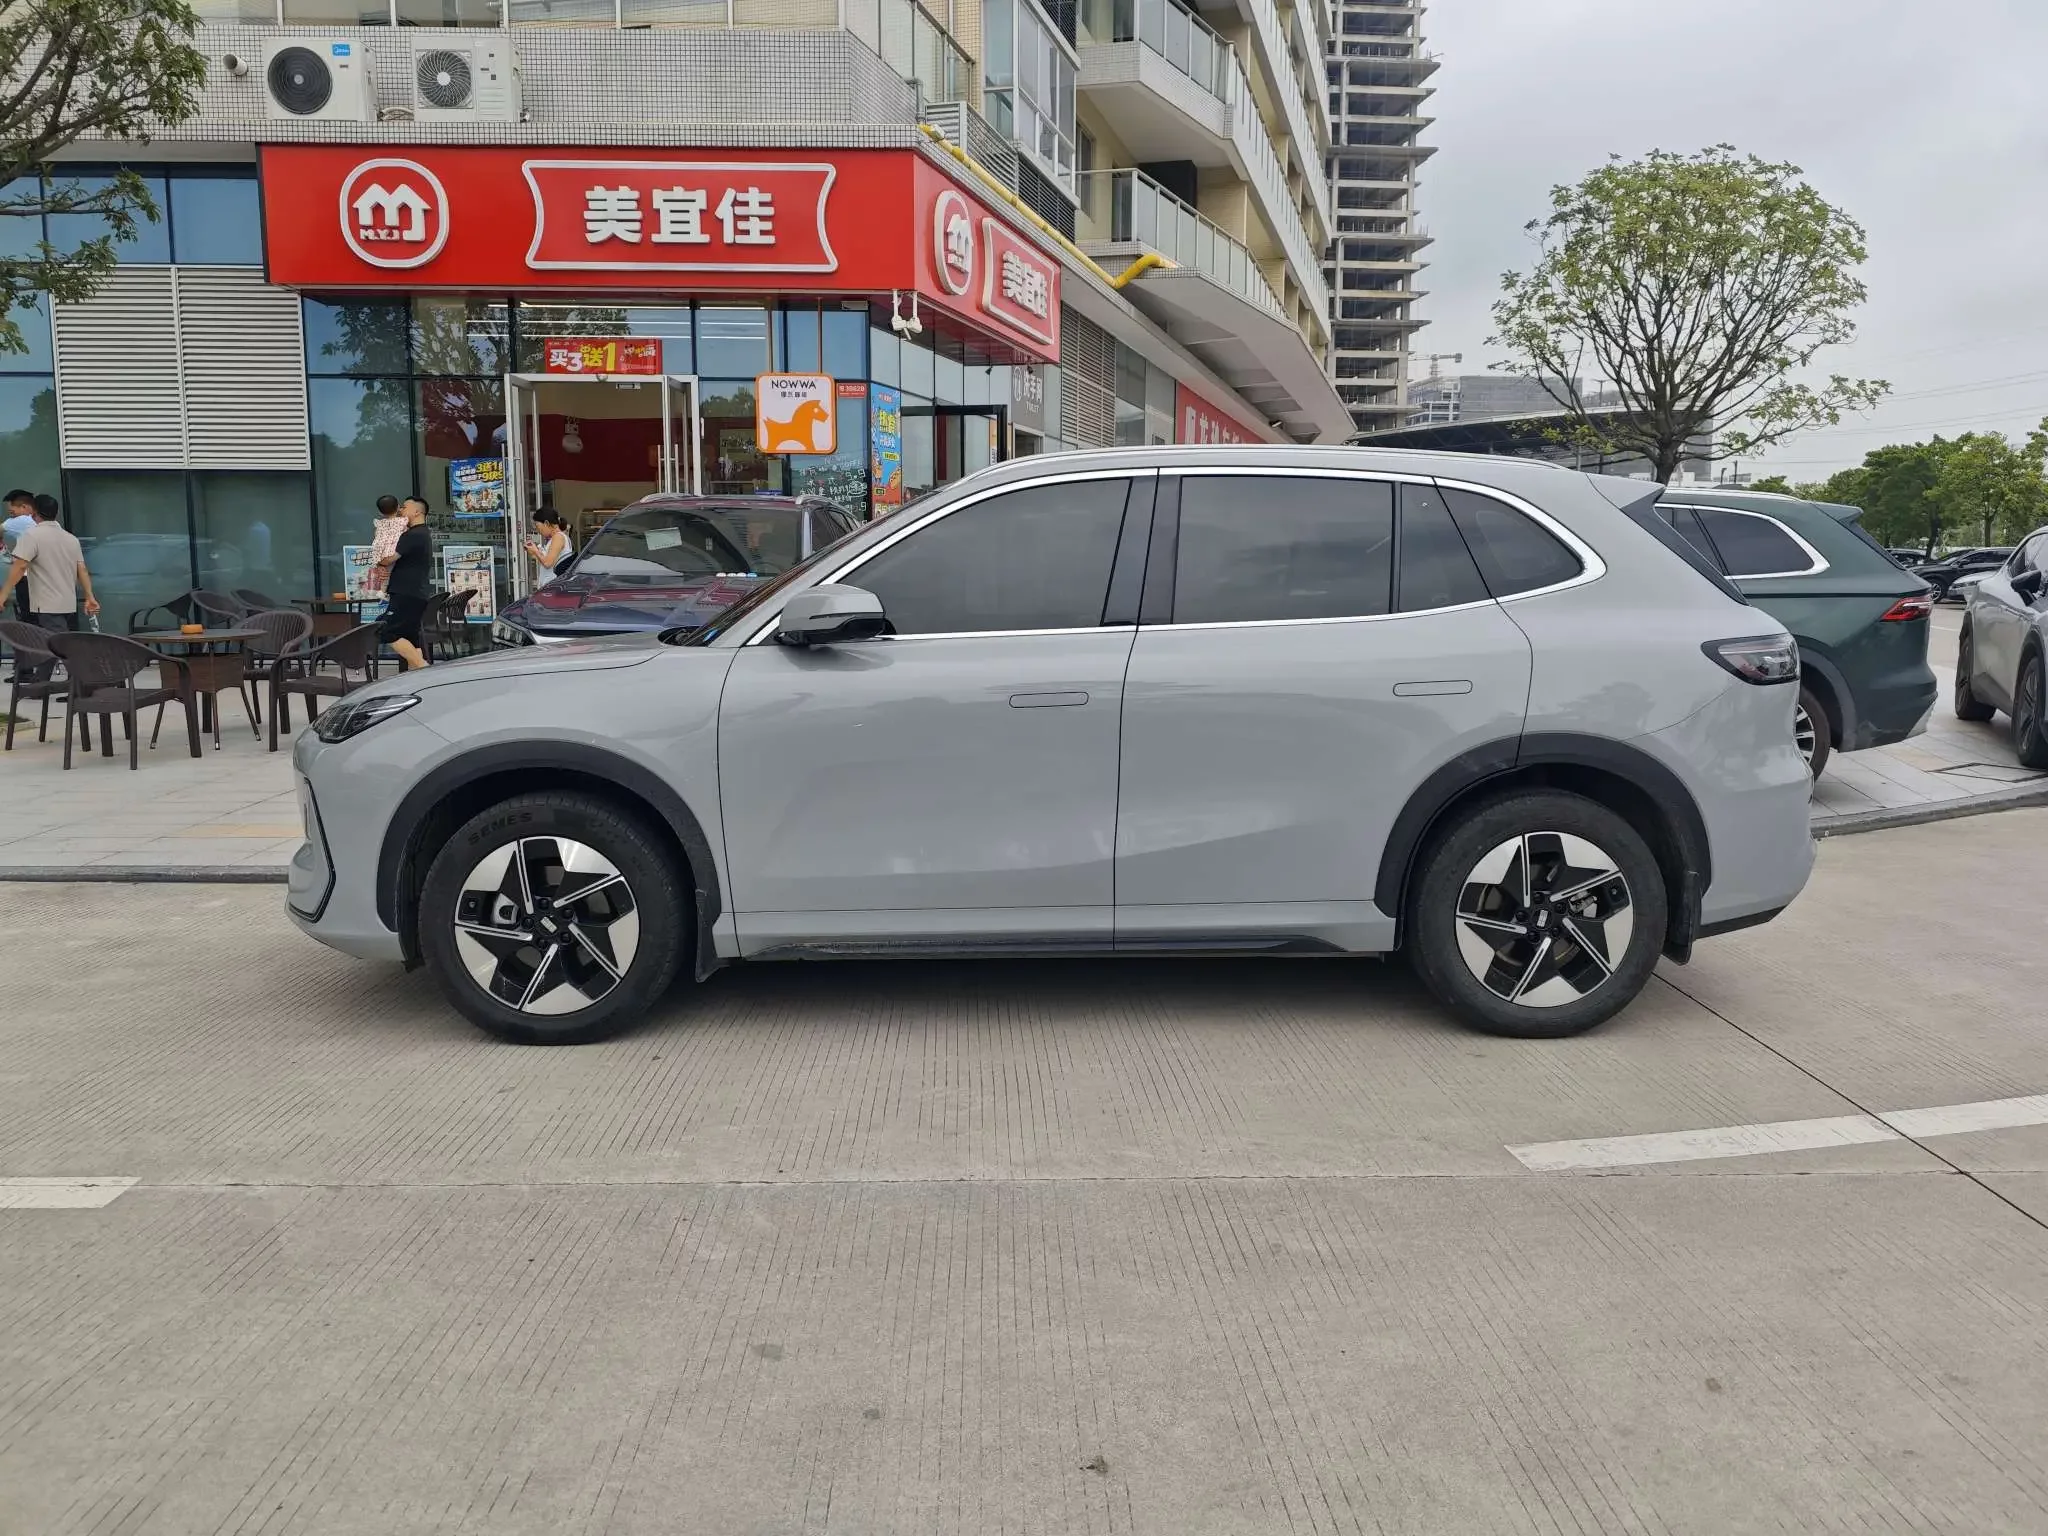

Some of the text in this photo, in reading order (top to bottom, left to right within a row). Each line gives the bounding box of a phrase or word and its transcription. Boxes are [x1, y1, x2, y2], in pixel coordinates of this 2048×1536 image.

[583, 185, 776, 244] 美宜佳
[1002, 250, 1048, 320] 美宜佳
[771, 379, 817, 390] NOWWA
